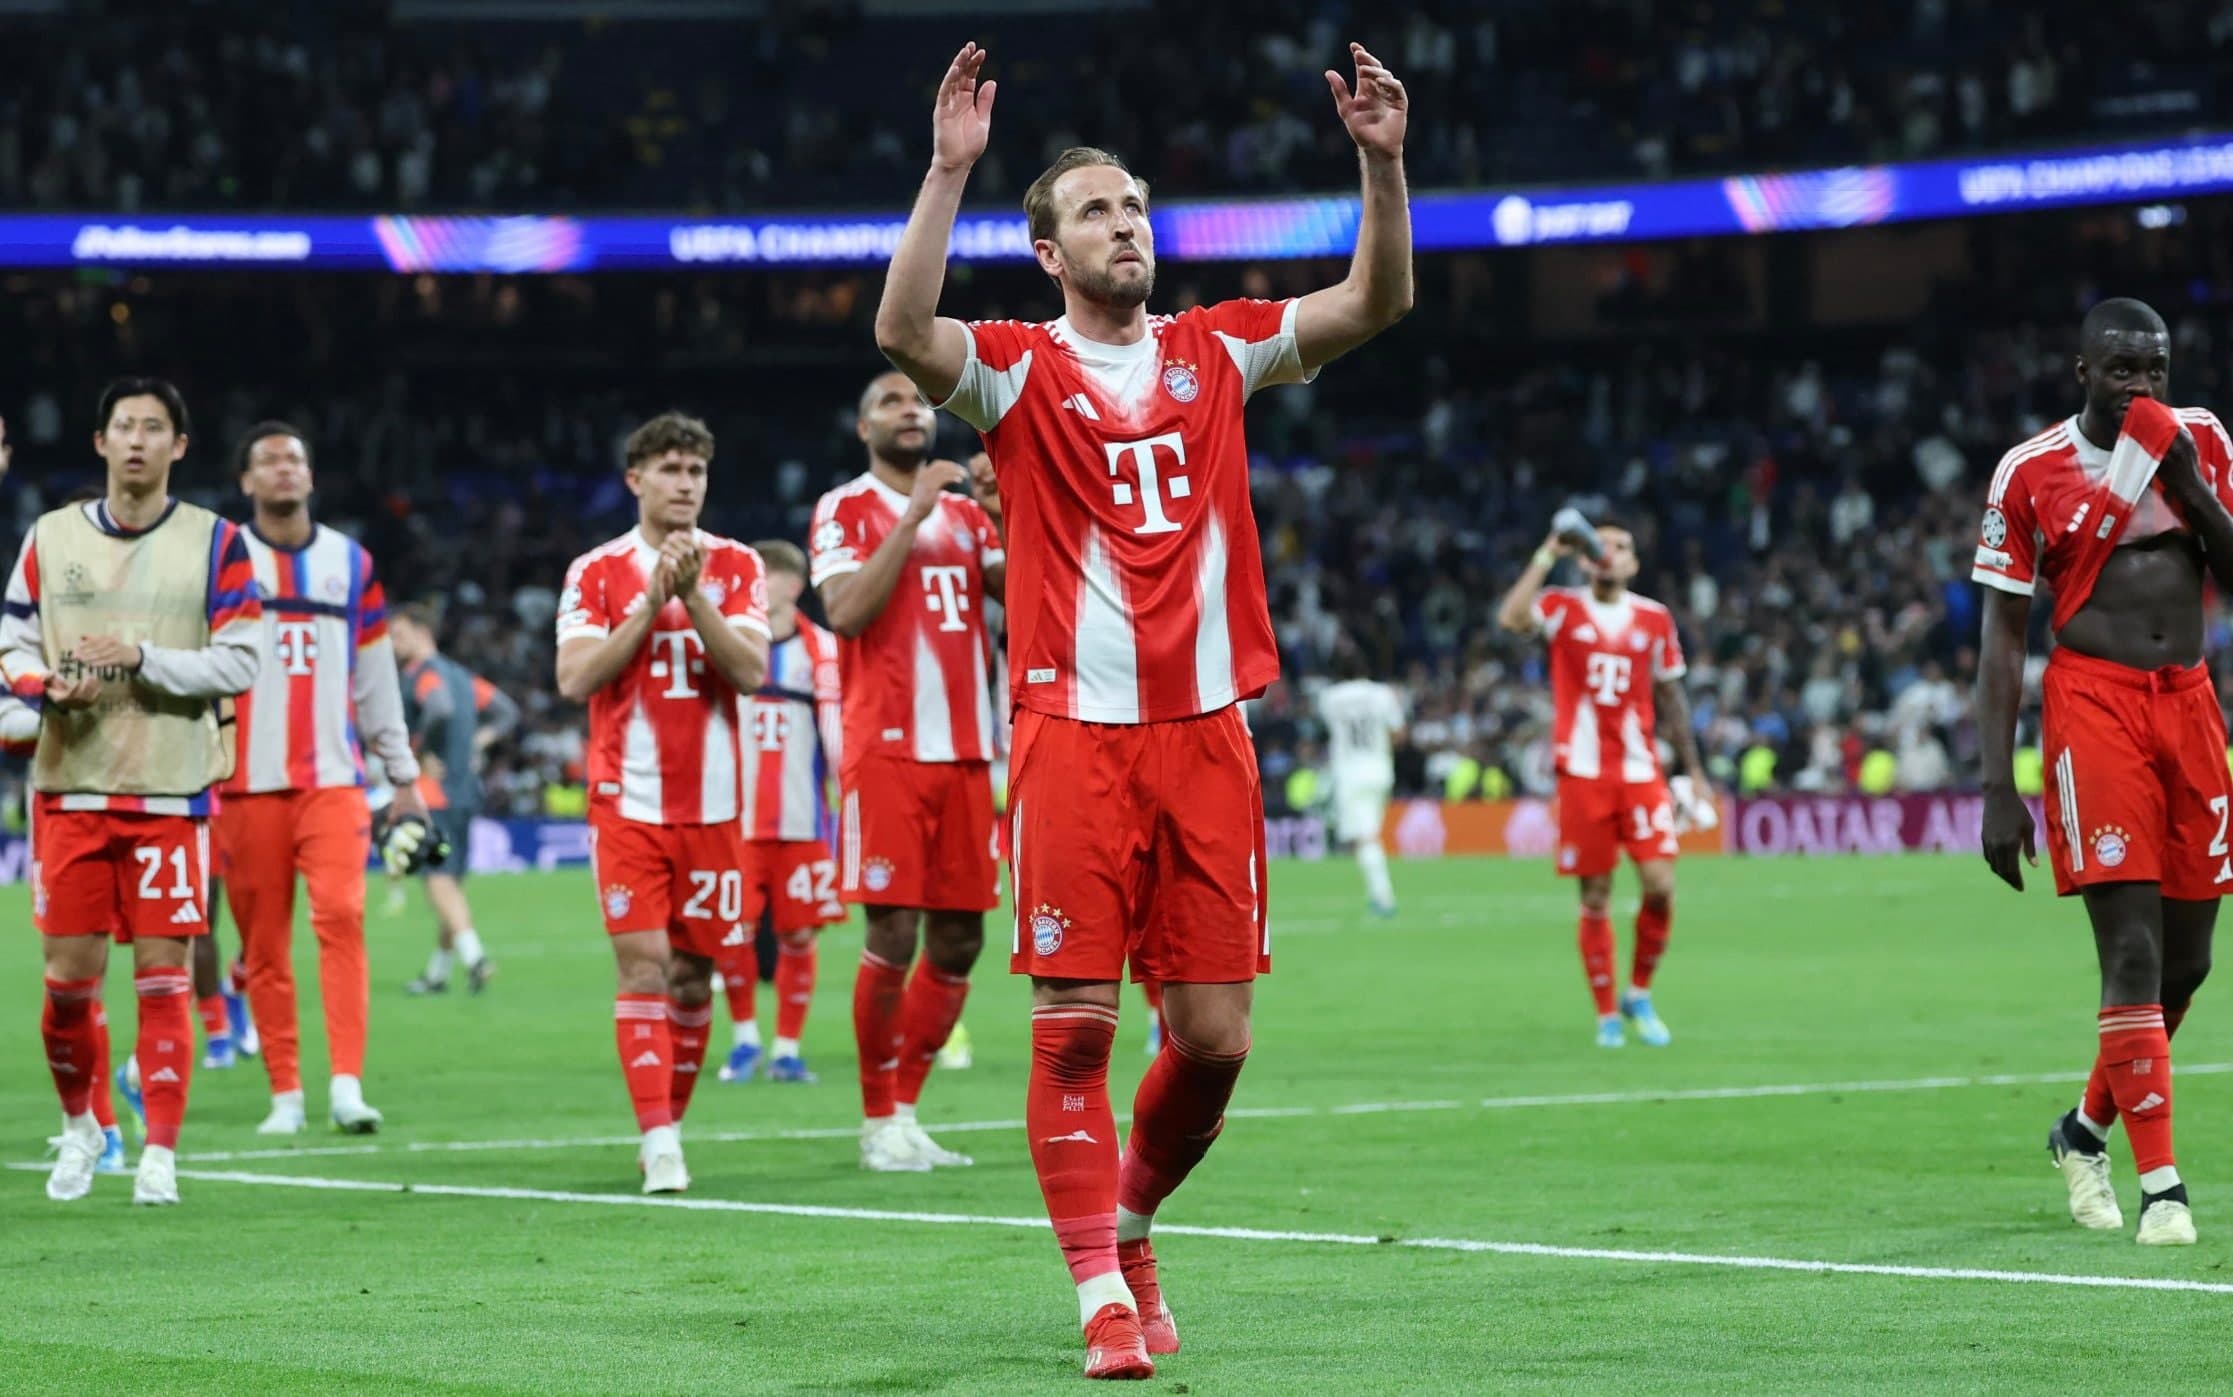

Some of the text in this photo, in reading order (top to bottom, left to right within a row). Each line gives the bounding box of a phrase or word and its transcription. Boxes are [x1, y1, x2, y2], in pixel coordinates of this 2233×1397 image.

[1104, 432, 1190, 534] T
[921, 566, 969, 632] T
[277, 622, 319, 674] T
[650, 630, 704, 698] T
[1586, 652, 1632, 707] T
[753, 703, 791, 749] T
[1634, 802, 1676, 840] 14
[1741, 799, 1902, 856] QATAR
[2208, 794, 2229, 857] 2
[135, 846, 194, 900] 21
[683, 870, 743, 922] 20
[788, 859, 839, 905] 42
